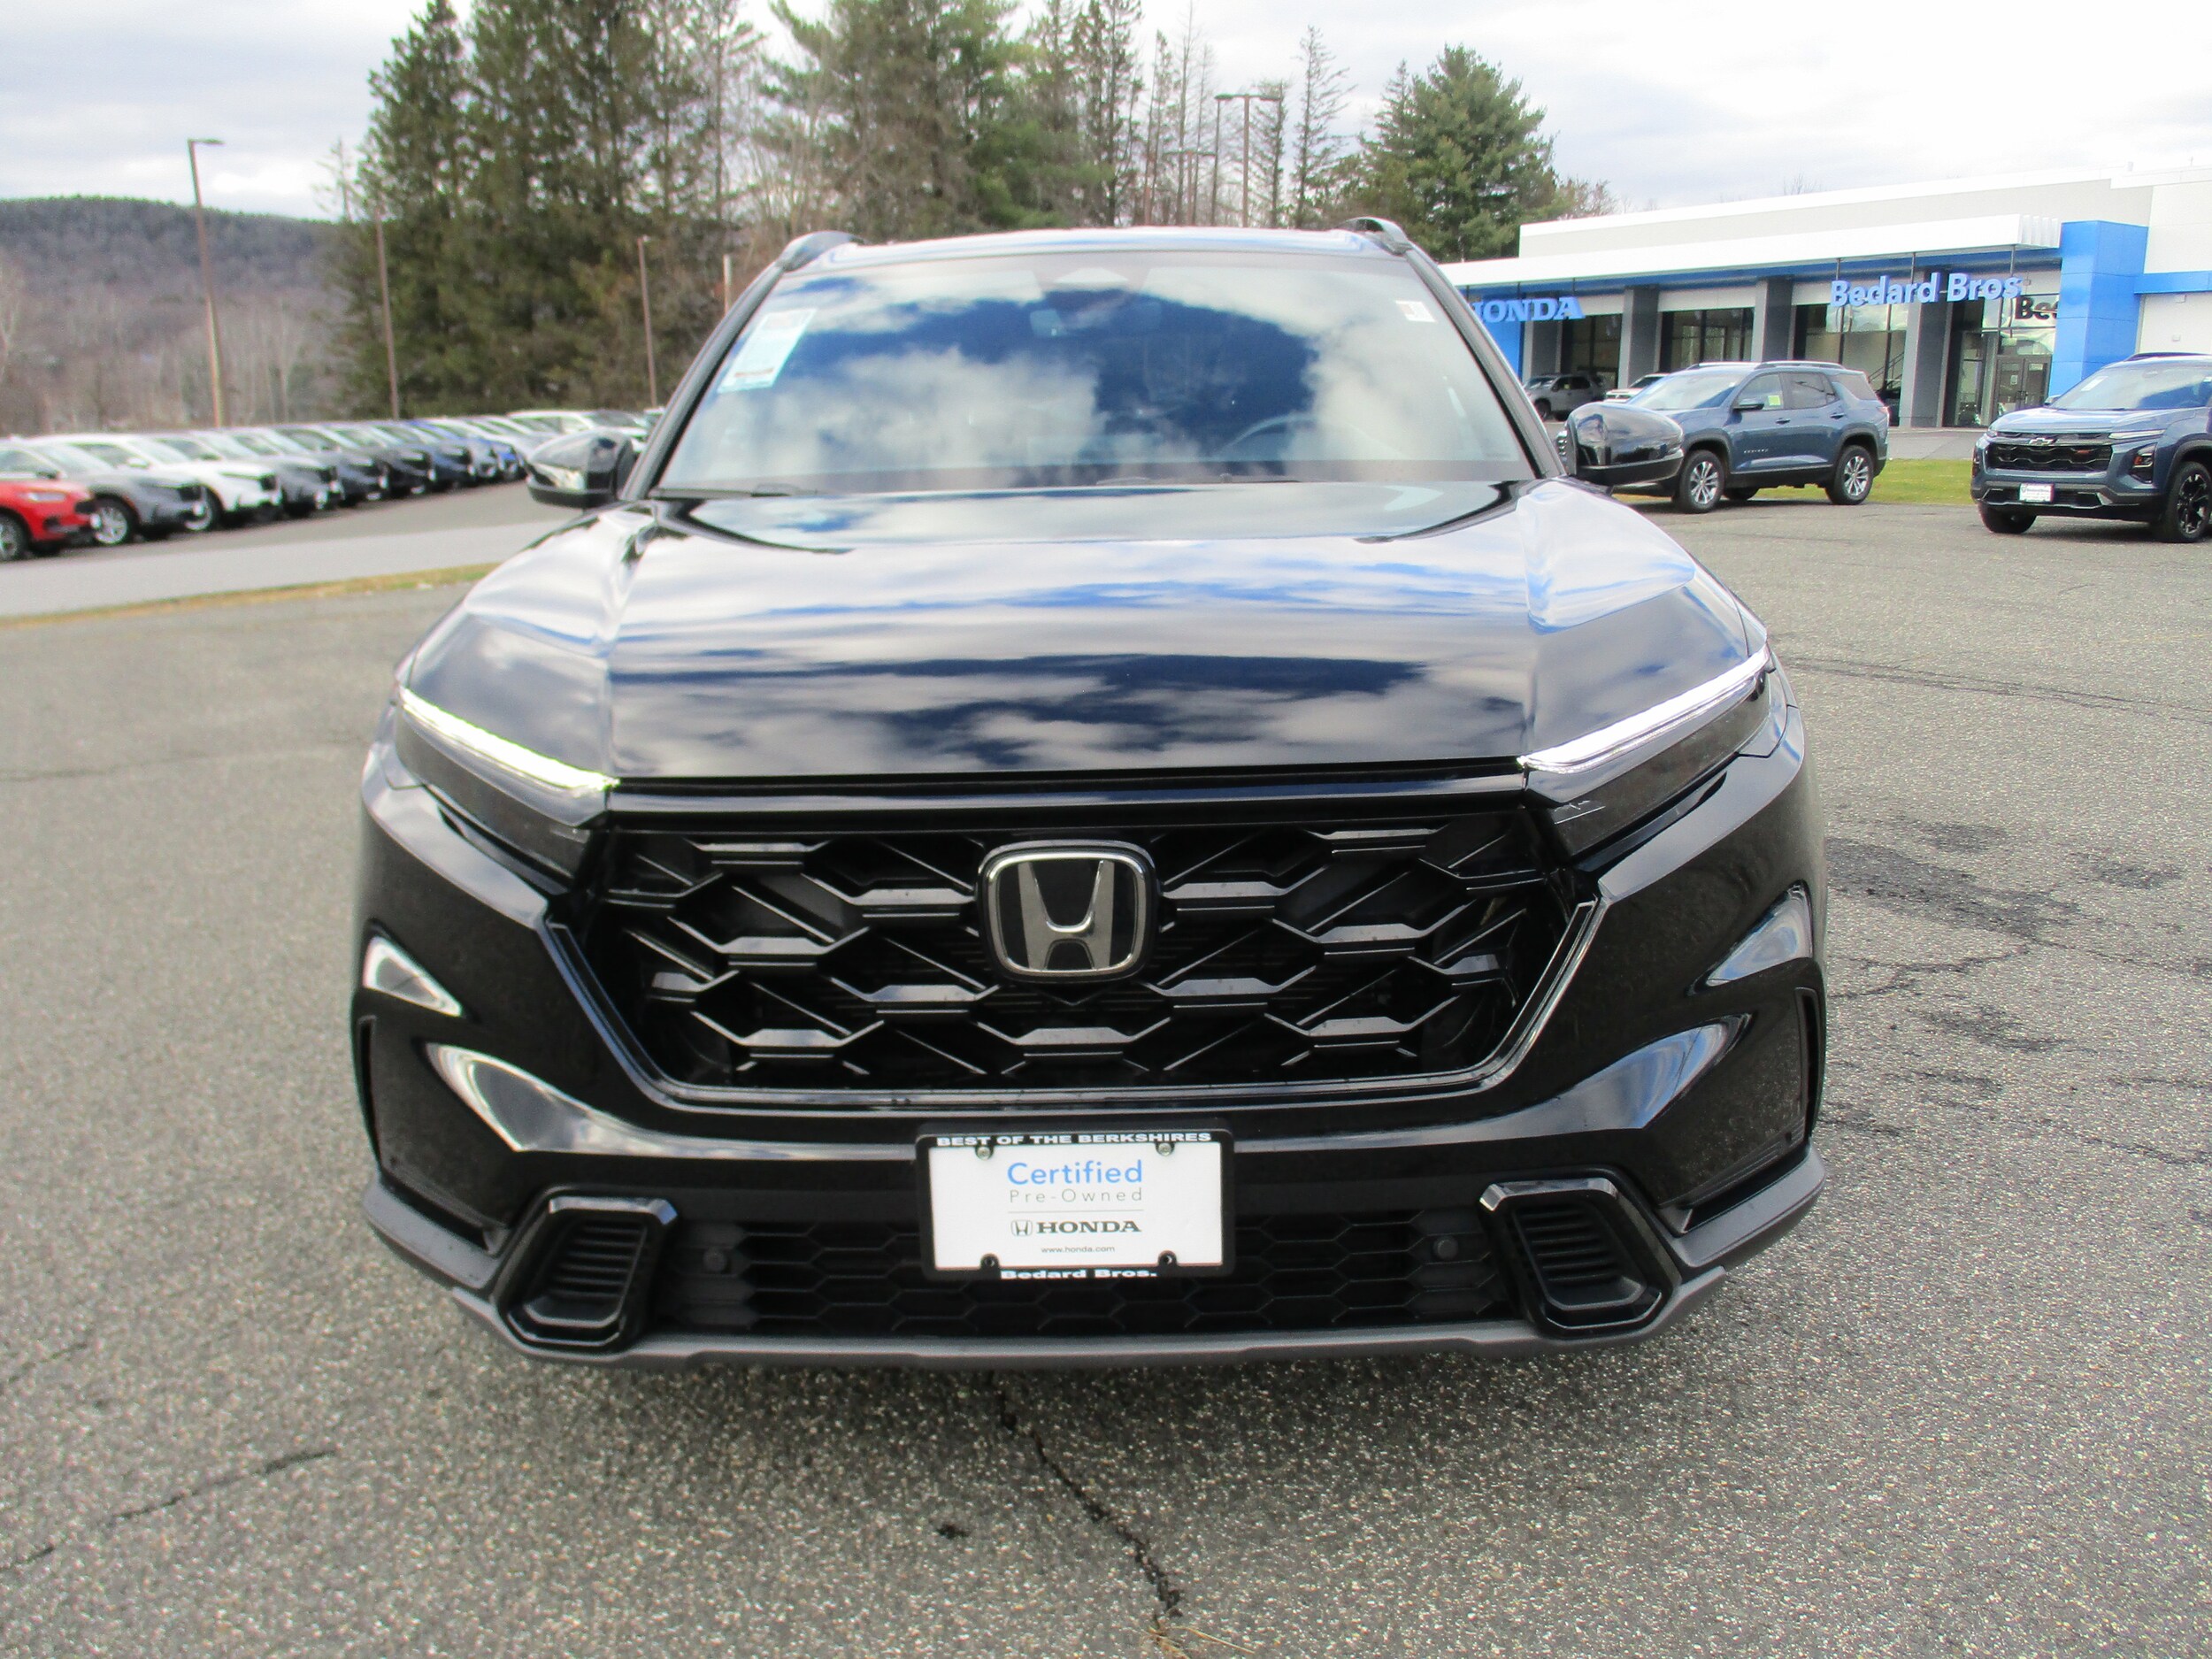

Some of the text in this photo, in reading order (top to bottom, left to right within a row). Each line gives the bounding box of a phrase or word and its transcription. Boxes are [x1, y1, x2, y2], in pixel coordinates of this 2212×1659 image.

[1831, 272, 2023, 307] Bedard Bros
[936, 1133, 1211, 1147] BEST OF THE BERKSHIRES
[1007, 1159, 1142, 1185] Certified
[1010, 1187, 1142, 1203] Pre-Owned
[1036, 1220, 1141, 1233] HONDA
[1001, 1268, 1157, 1279] Bedard Bros.
